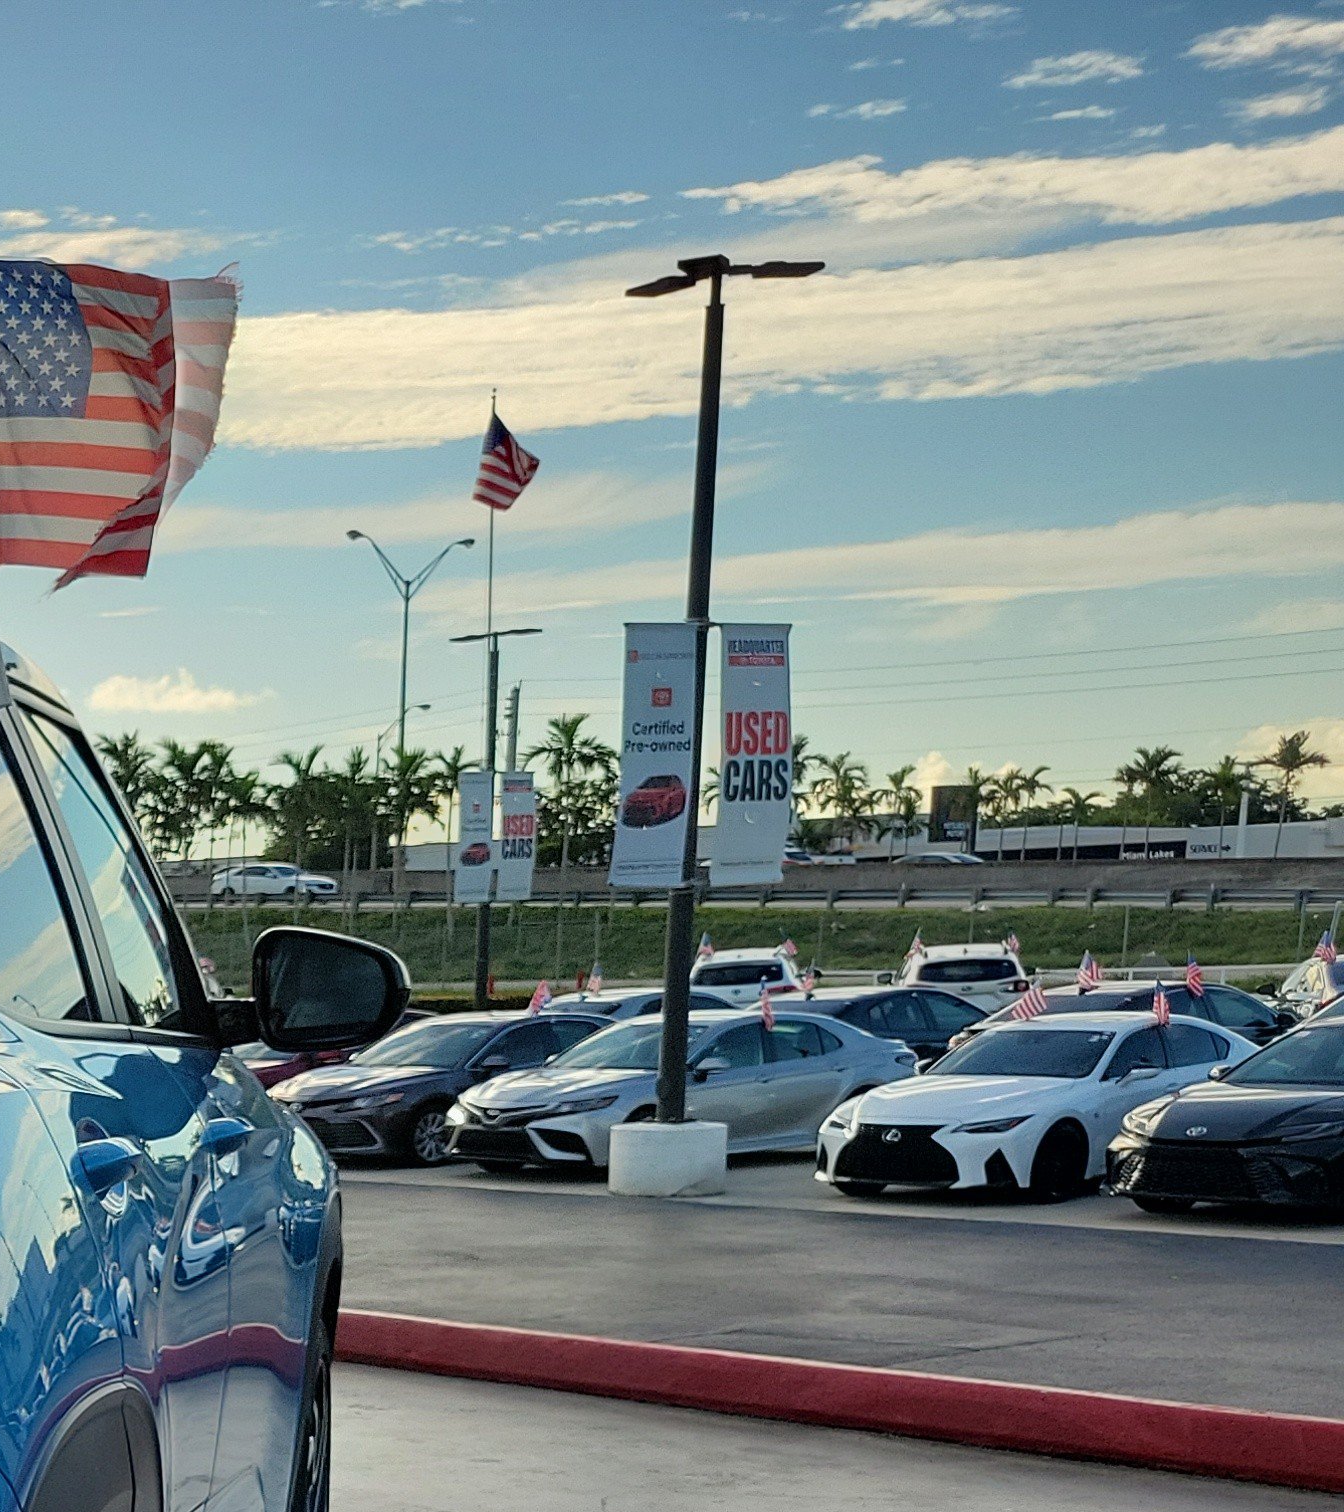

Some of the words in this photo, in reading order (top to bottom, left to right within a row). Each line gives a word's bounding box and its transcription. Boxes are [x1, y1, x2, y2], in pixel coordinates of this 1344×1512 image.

[632, 719, 685, 735] Certified
[725, 711, 788, 756] USED
[624, 737, 691, 753] Pre-owned
[724, 759, 788, 801] CARS
[503, 814, 534, 837] USED
[501, 838, 533, 860] CARS
[1149, 850, 1174, 859] Lakes
